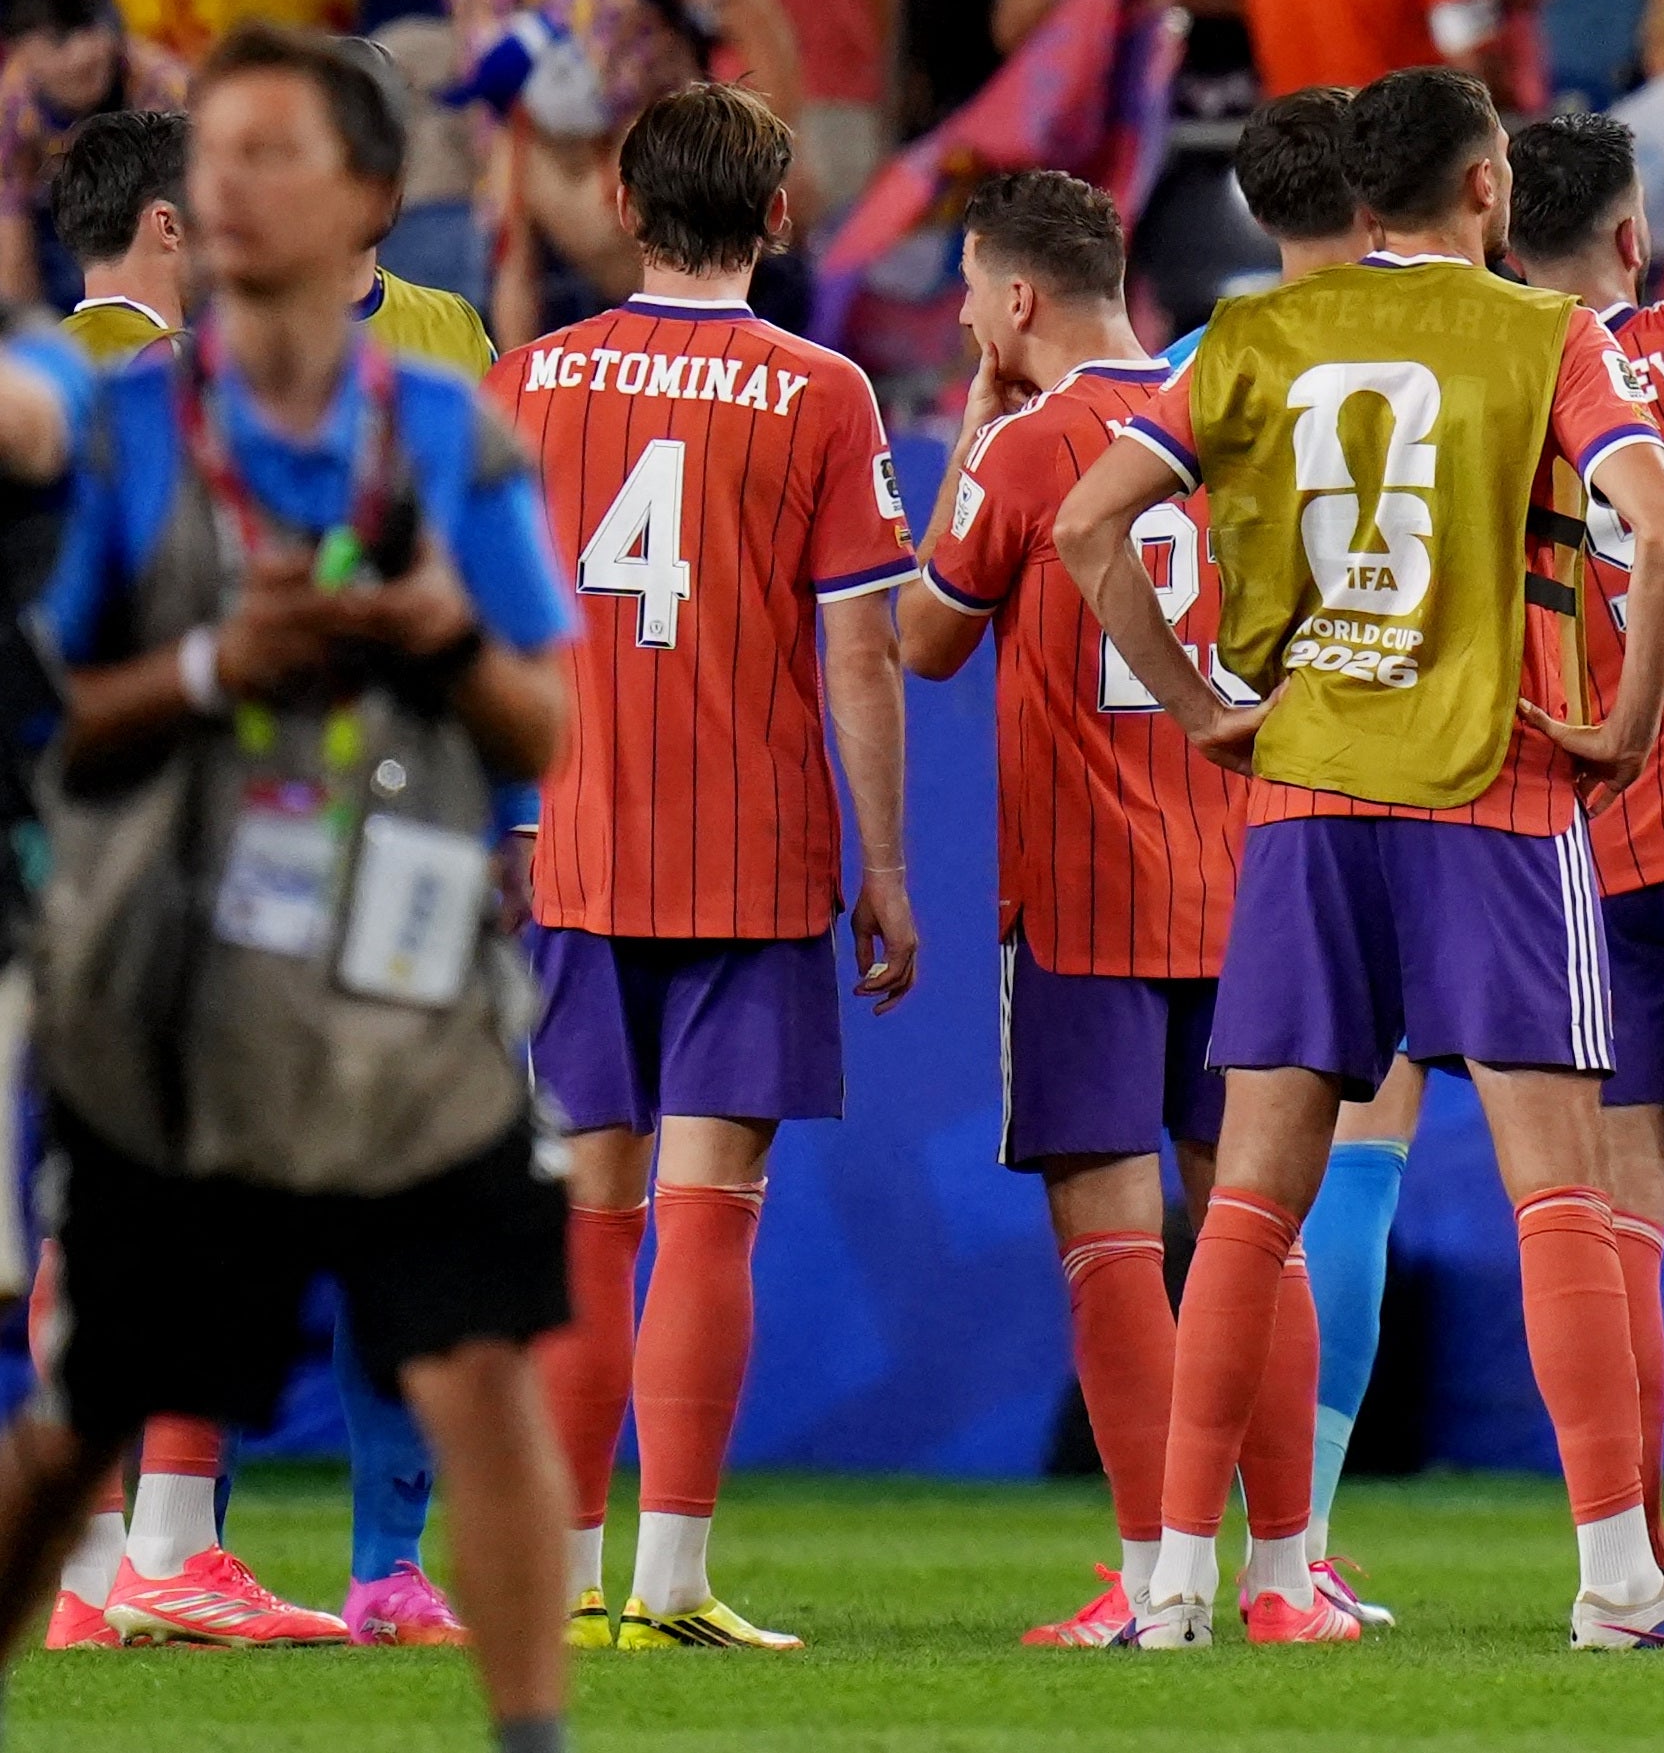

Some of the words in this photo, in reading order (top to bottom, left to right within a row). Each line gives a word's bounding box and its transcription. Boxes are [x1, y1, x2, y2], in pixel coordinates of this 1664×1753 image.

[576, 439, 691, 649] 4
[1346, 566, 1399, 591] IFA
[1382, 627, 1424, 651] CUP
[1285, 639, 1420, 689] 2026
